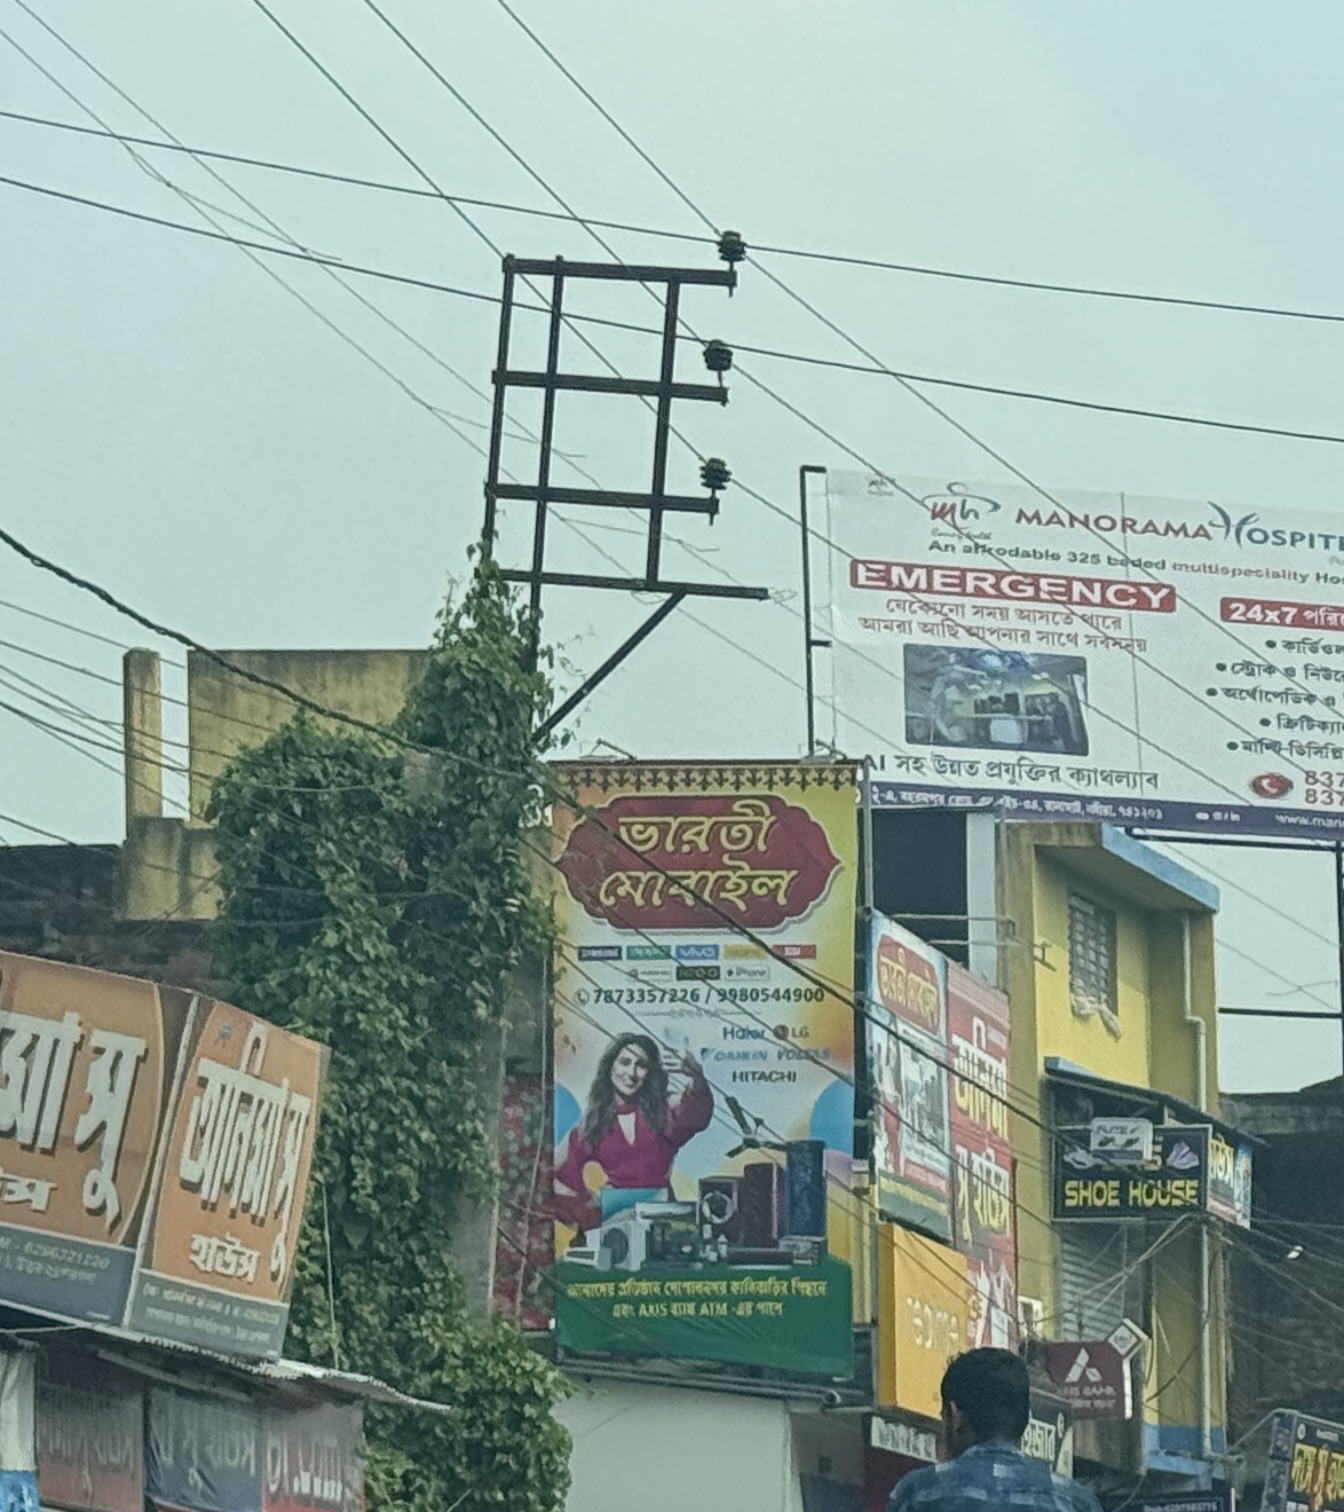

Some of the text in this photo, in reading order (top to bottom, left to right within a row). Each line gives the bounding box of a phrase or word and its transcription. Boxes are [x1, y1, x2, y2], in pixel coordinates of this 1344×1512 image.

[1015, 508, 1212, 542] MANORAMA
[928, 540, 956, 554] An
[1067, 551, 1101, 565] 325
[856, 561, 1171, 610] EMERGENCY
[1227, 601, 1299, 626] 24x7
[894, 754, 927, 774] সহ
[618, 799, 777, 852] ভারতী
[600, 852, 799, 912] মোবাইল
[732, 1070, 798, 1084] HITACHI
[1065, 1179, 1200, 1208] SHOE HOUSE
[190, 1232, 260, 1283] হাউস
